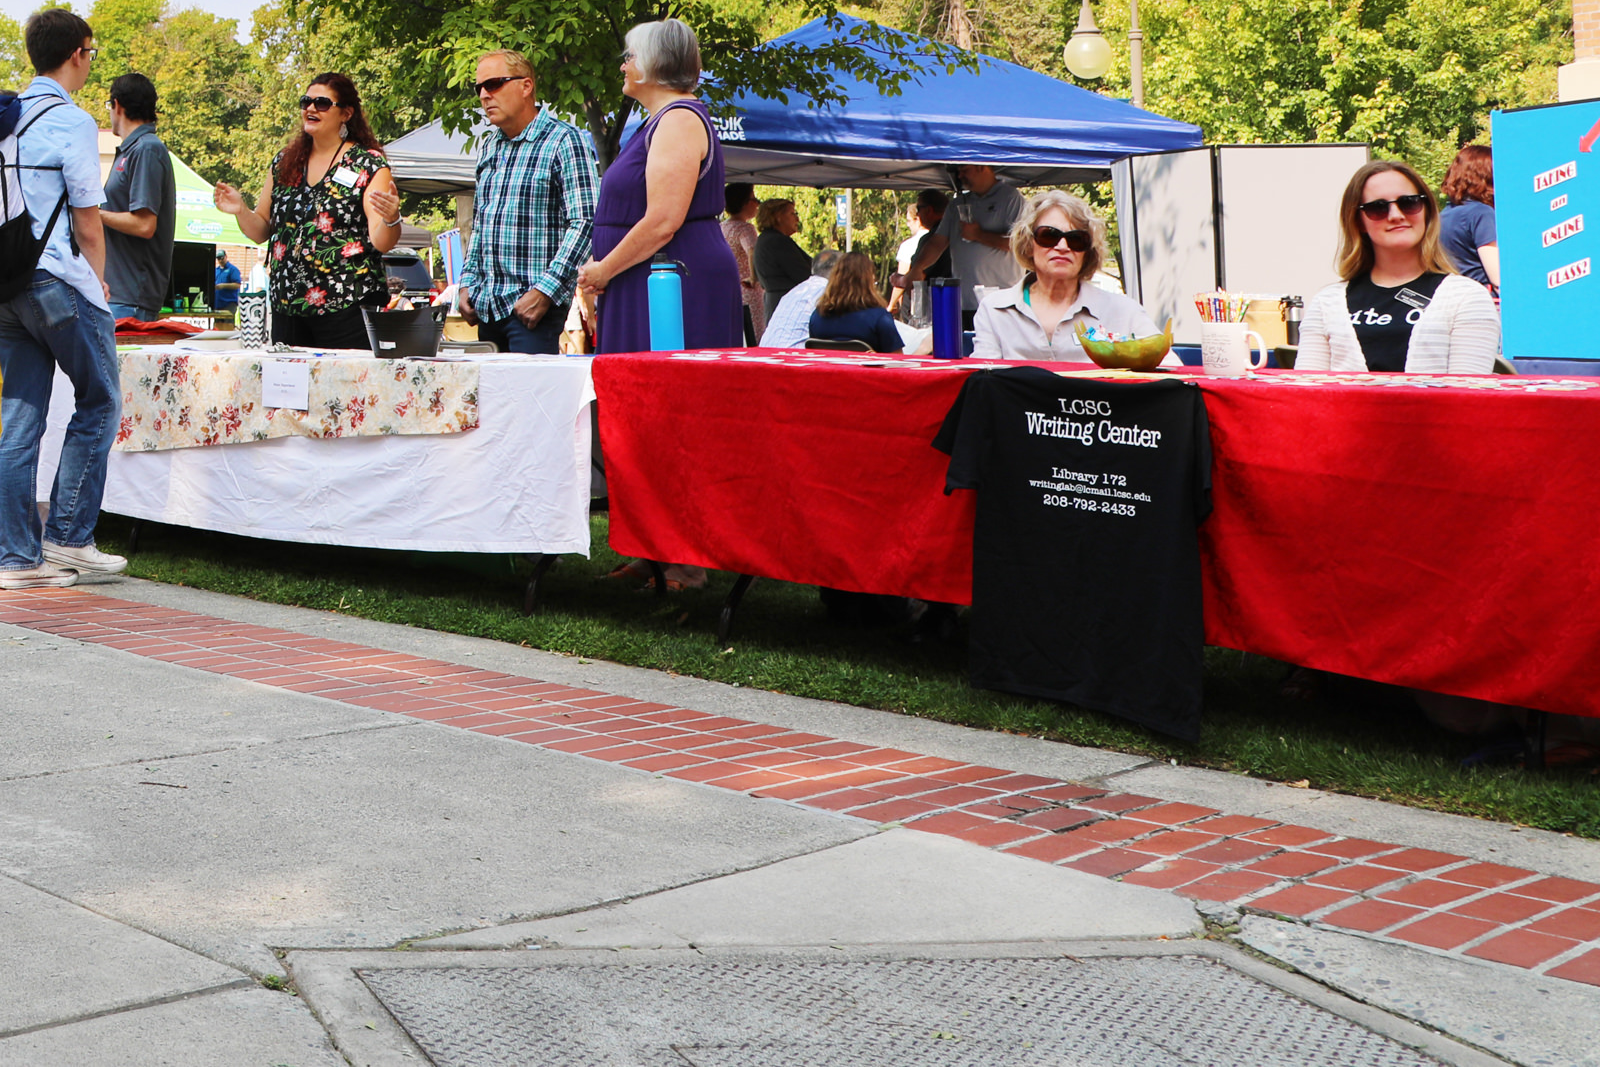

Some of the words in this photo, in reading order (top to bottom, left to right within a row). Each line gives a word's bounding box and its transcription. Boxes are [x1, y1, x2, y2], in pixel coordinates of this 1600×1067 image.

[716, 130, 747, 141] HADE
[1536, 164, 1575, 190] TAKING
[1551, 197, 1566, 209] an
[1543, 217, 1581, 246] ONLINE
[1549, 261, 1587, 287] CLASS?
[1058, 398, 1112, 416] LCSC
[1025, 411, 1095, 446] Writing
[1098, 420, 1161, 448] Center
[1052, 467, 1099, 485] Library
[1102, 473, 1127, 486] 172
[1029, 480, 1151, 502] writinglab@lcmail.lcsc.edu
[1043, 494, 1136, 517] 208-792-2433
